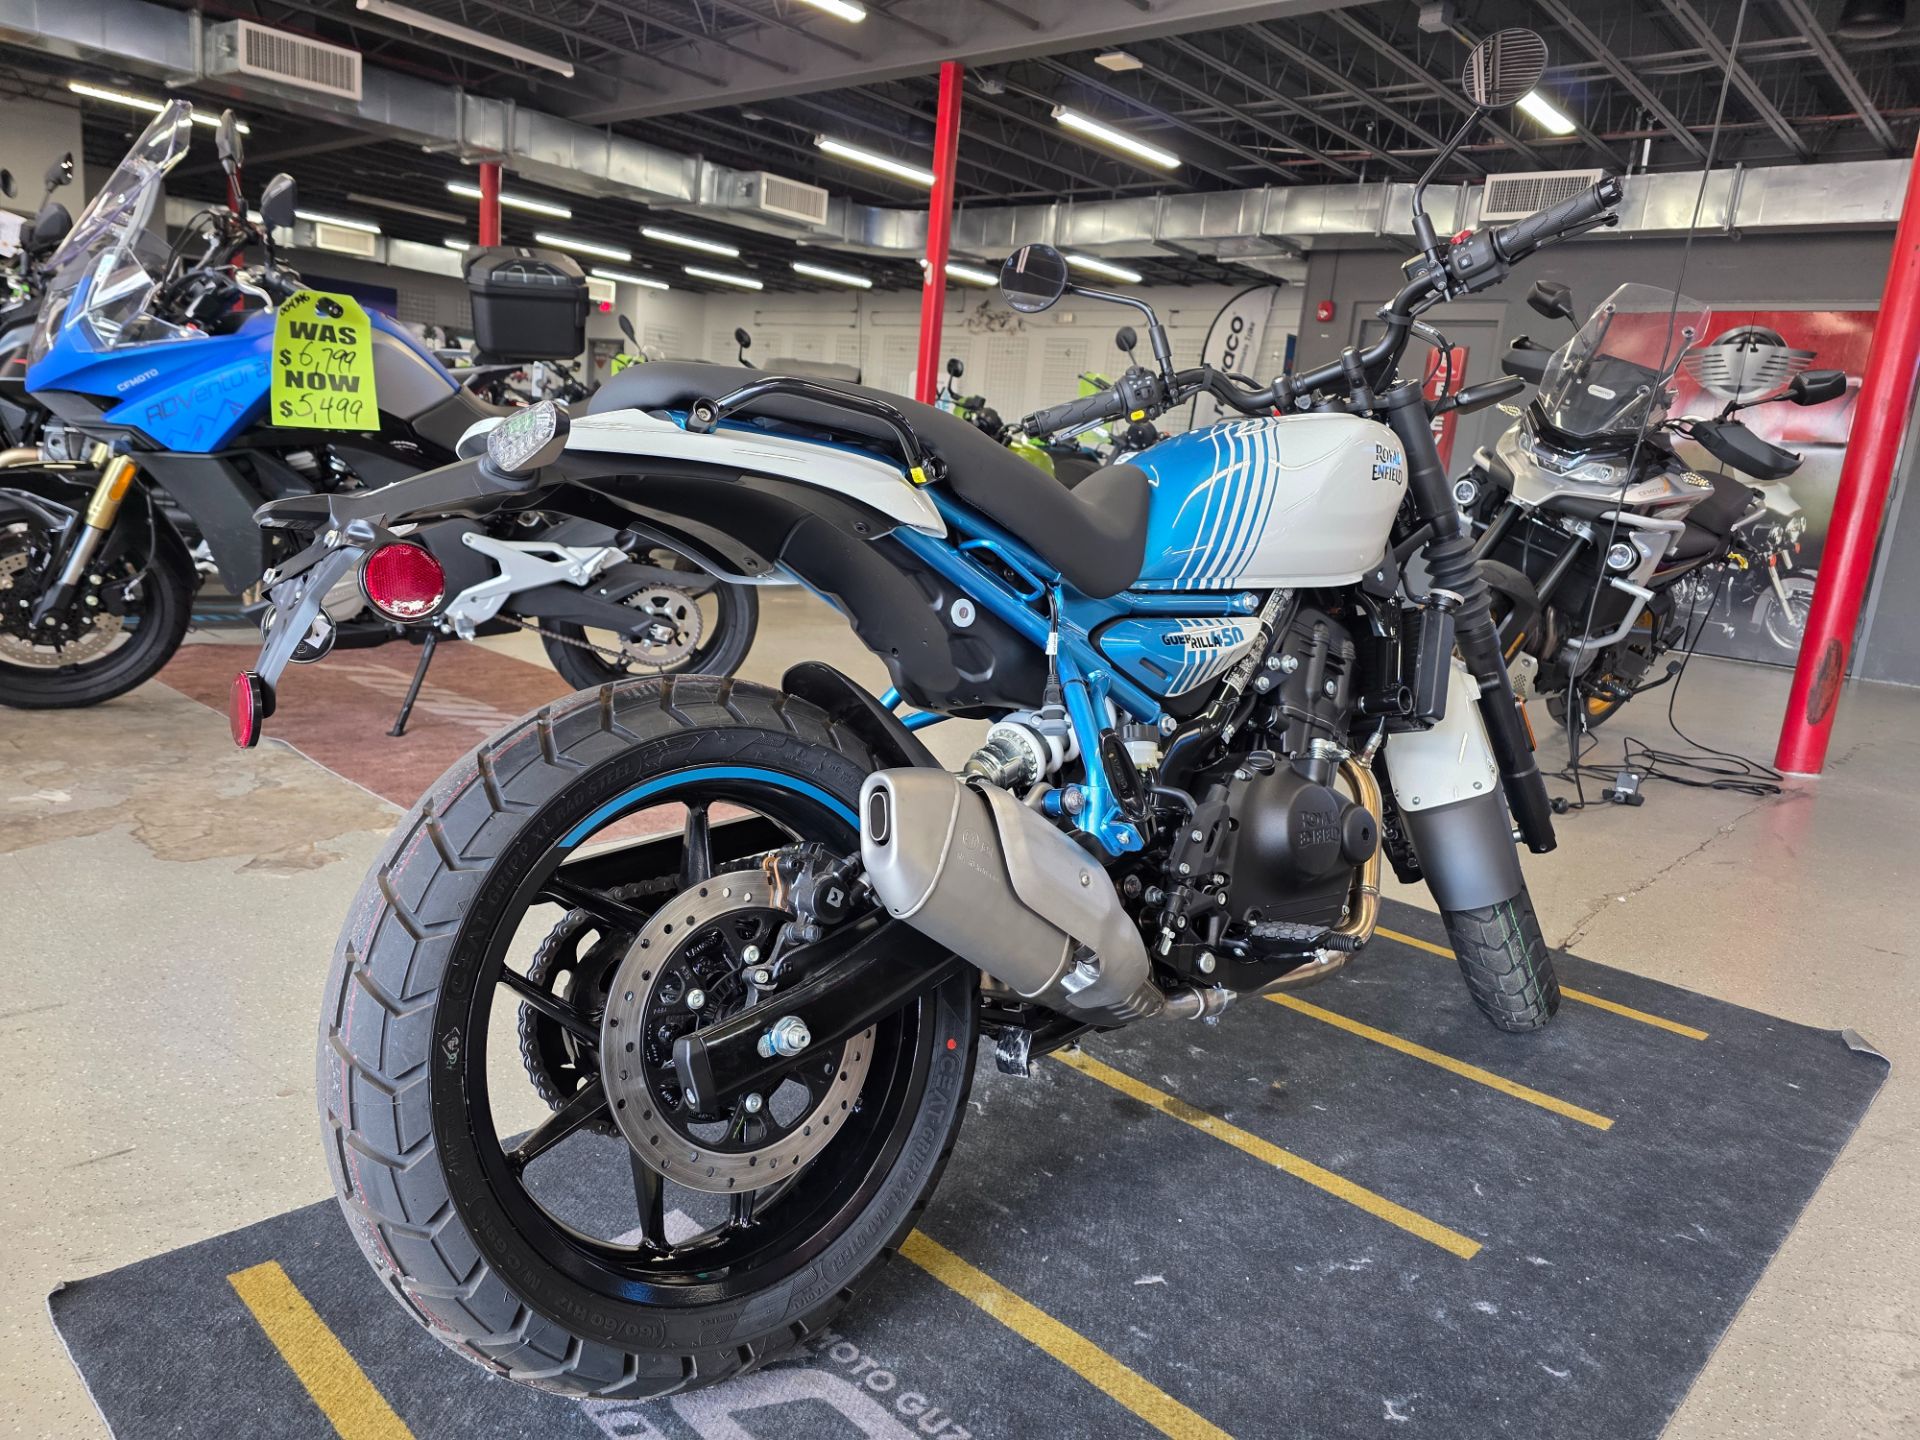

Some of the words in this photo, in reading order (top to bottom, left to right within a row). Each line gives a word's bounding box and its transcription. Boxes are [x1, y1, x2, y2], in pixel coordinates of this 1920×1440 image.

[289, 320, 357, 346] WAS
[1213, 315, 1244, 417] raco
[116, 368, 160, 392] CFMOTO
[285, 369, 360, 393] NOW
[1375, 443, 1401, 465] ROYAL
[1371, 463, 1403, 486] ENFIELD
[1161, 633, 1221, 649] GUERRILLA
[1210, 626, 1245, 647] 450
[927, 1055, 957, 1123] CEAT
